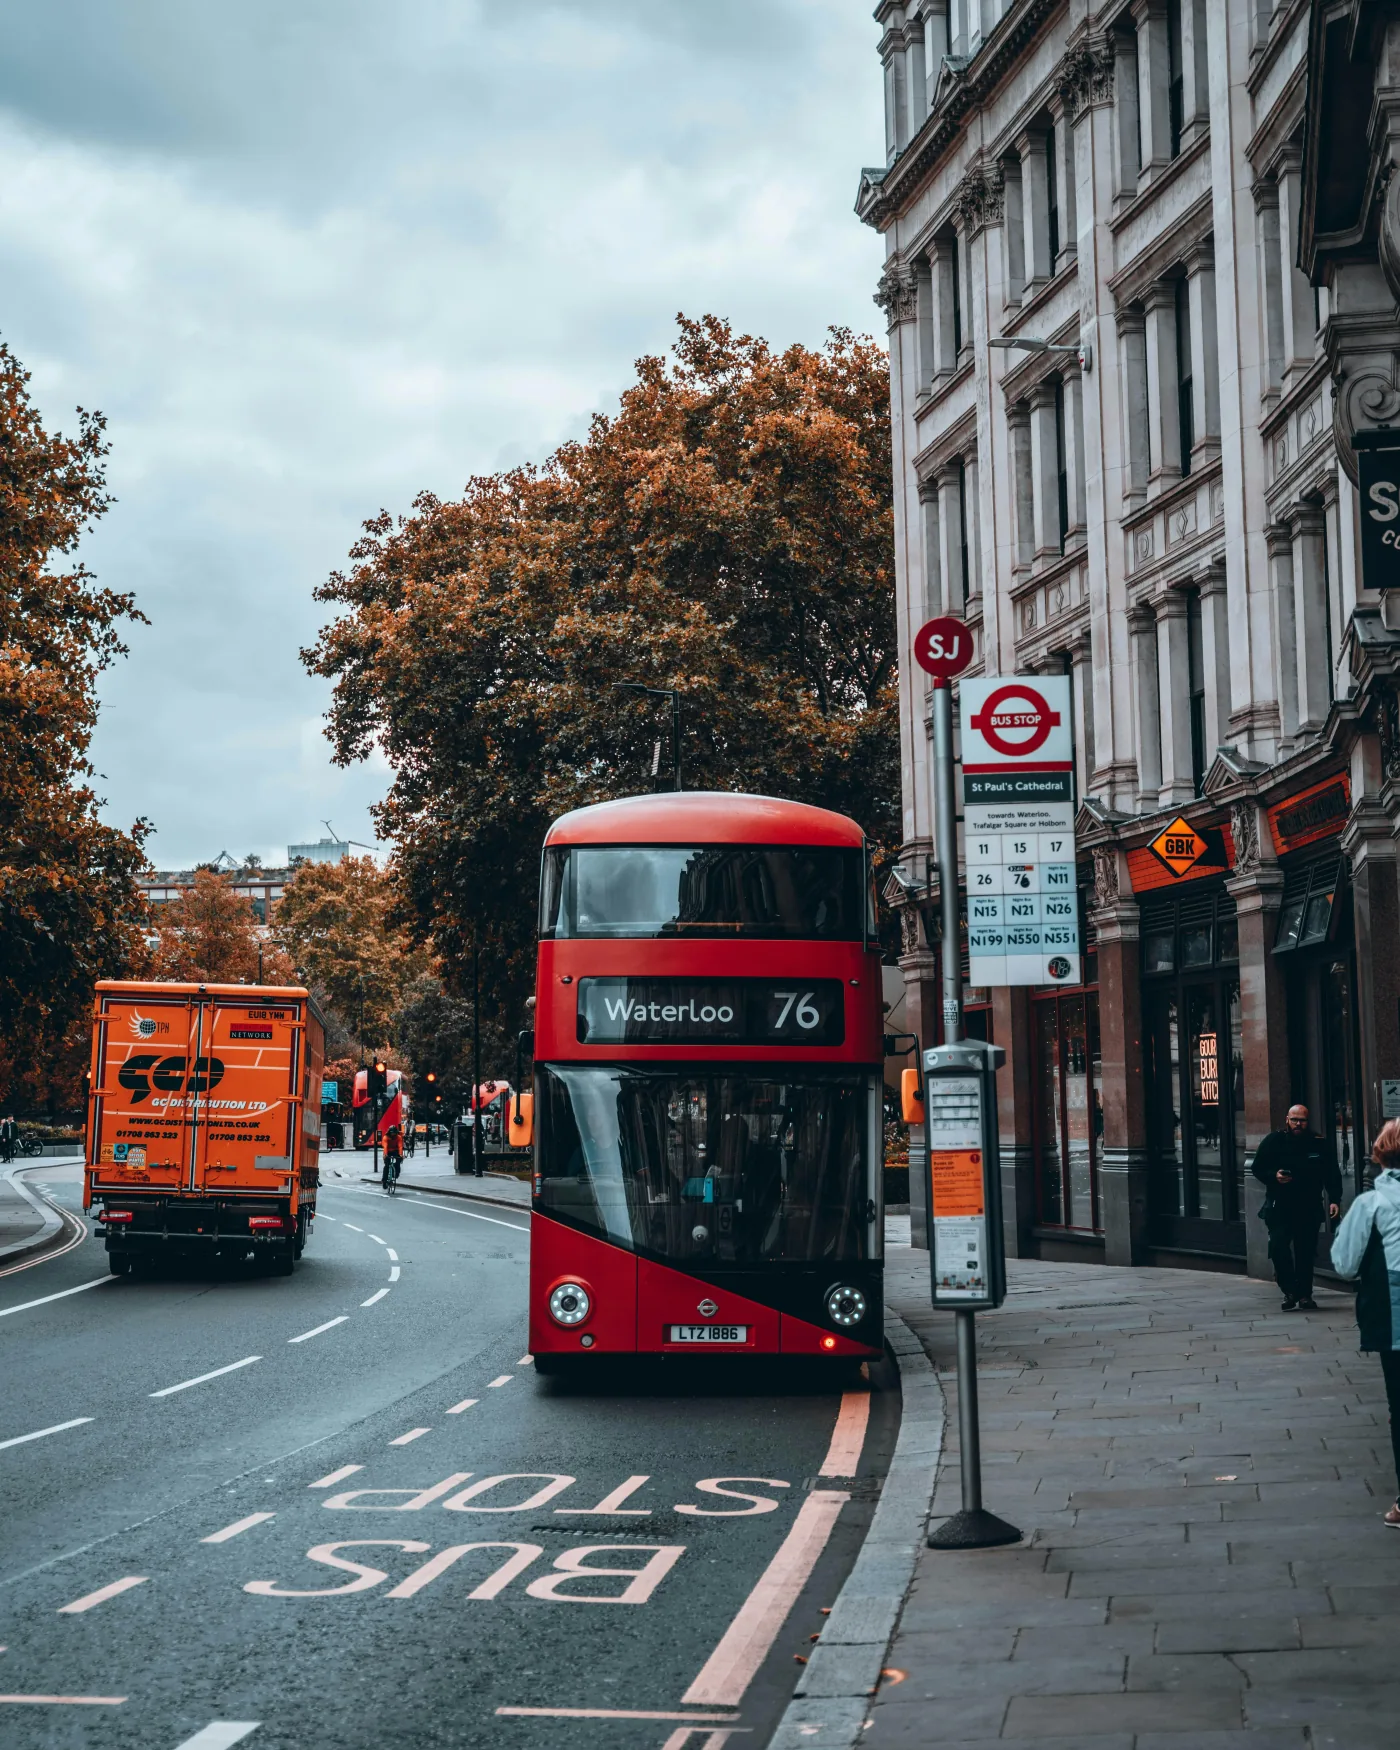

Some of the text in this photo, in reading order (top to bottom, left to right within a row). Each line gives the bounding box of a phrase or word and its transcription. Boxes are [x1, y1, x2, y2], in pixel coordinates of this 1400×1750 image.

[1368, 481, 1400, 522] S
[927, 634, 960, 660] SJ
[990, 714, 1042, 726] BUS STOP
[972, 781, 1064, 792] St Paul's Cathedral
[973, 822, 1002, 830] Trafalgar
[1004, 821, 1028, 829] Square
[978, 843, 989, 855] 11
[1013, 842, 1027, 854] 15
[1050, 841, 1063, 853] 17
[1165, 838, 1195, 855] GBK
[976, 874, 993, 885] 26
[1048, 873, 1069, 884] N11
[974, 905, 997, 917] N15
[1011, 904, 1034, 916] N21
[1046, 903, 1072, 915] N26
[970, 935, 1003, 946] N199
[1007, 933, 1040, 944] N550
[1044, 932, 1076, 943] N551
[604, 991, 821, 1030] Waterloo 76
[230, 1031, 272, 1039] NETWORK
[1200, 1038, 1218, 1056] GOUR
[1200, 1057, 1218, 1079] BUR
[1201, 1080, 1219, 1099] KITC
[151, 1097, 268, 1111] GC DISTRIBUTION LTD
[116, 1130, 142, 1138] 01708
[209, 1133, 235, 1141] 01708
[679, 1327, 738, 1340] LTZ 1886
[321, 1473, 791, 1517] STOP
[243, 1540, 687, 1604] BUS
